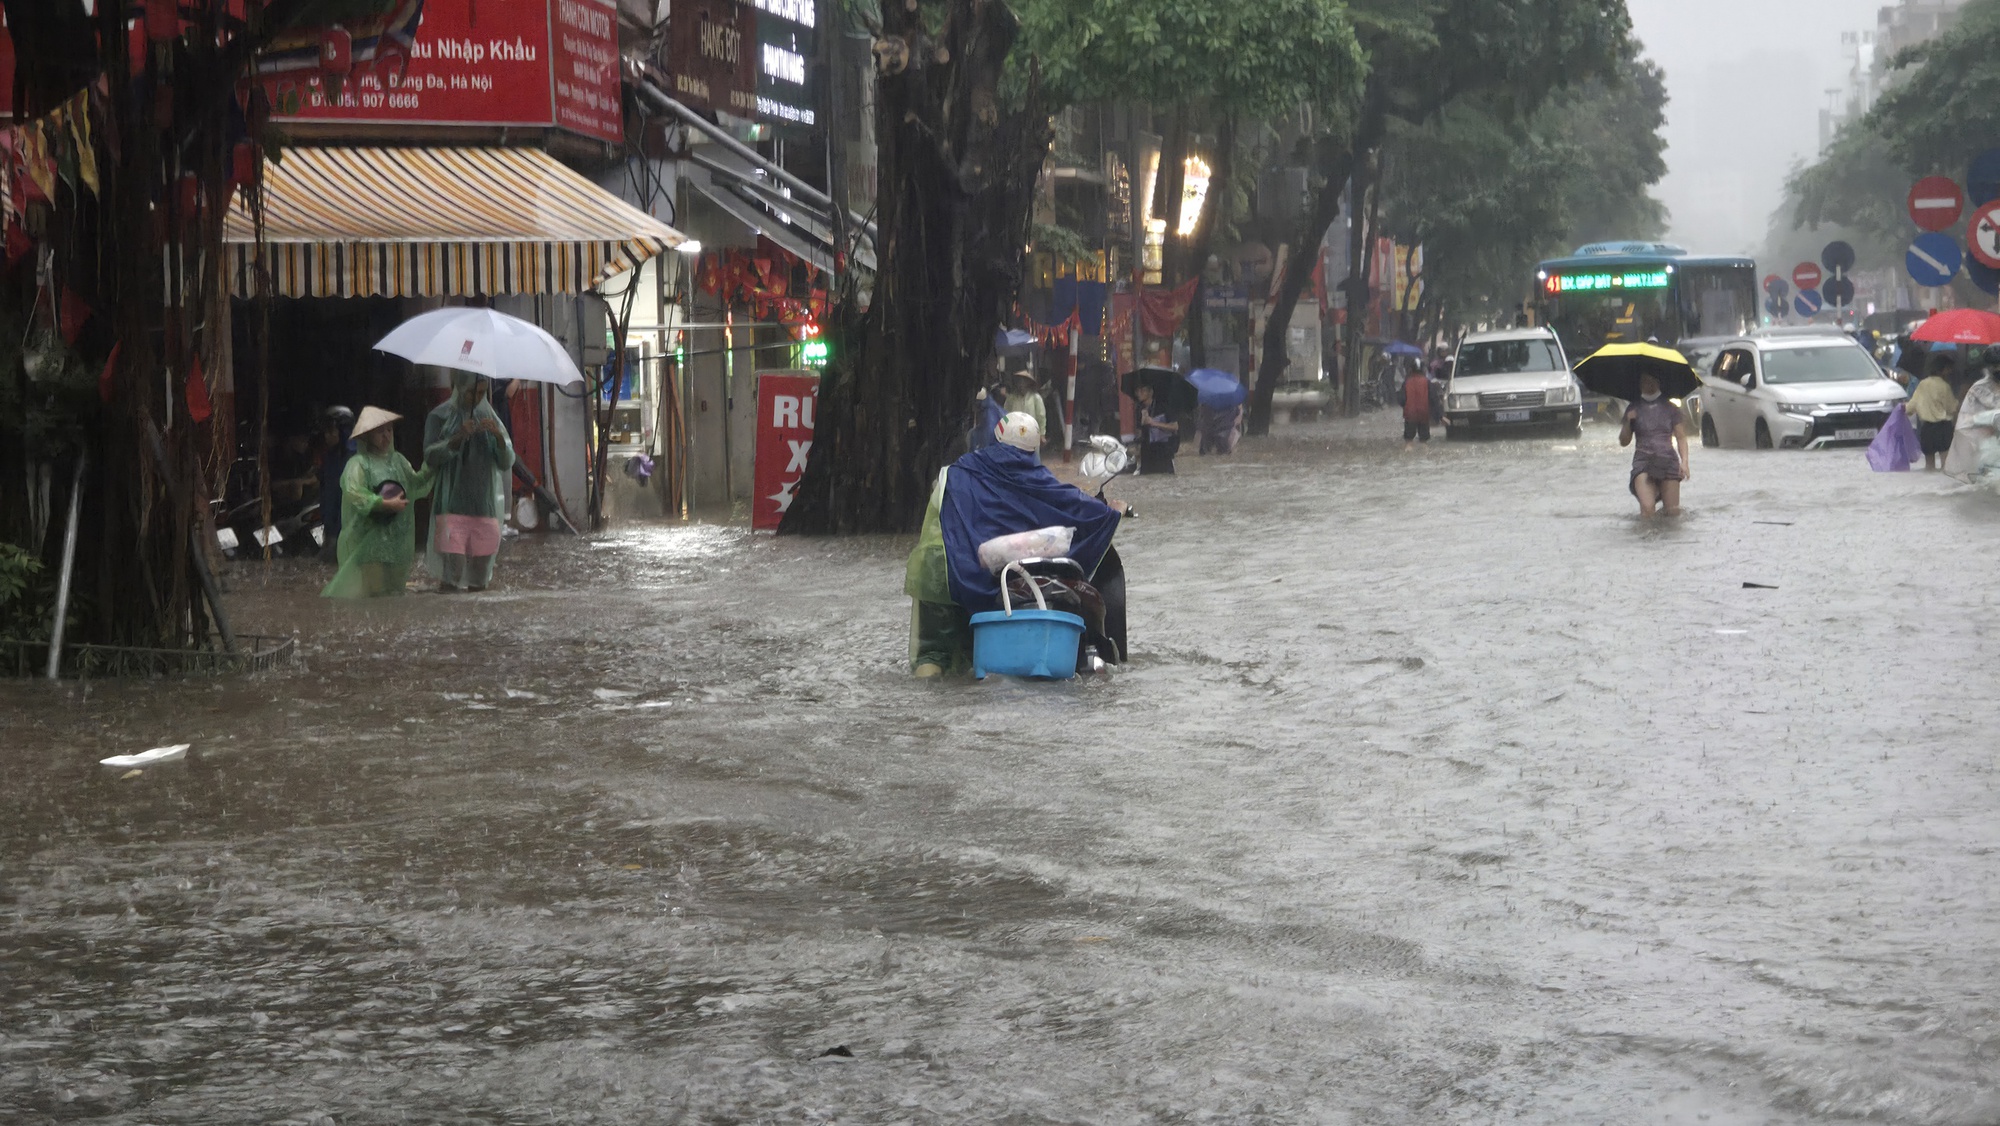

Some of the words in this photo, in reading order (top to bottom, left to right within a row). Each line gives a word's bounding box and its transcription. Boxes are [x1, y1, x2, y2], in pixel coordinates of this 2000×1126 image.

[590, 9, 611, 40] MOTOR
[437, 37, 484, 64] Nhập
[489, 35, 536, 60] Khẩu
[450, 73, 468, 89] Hà
[471, 74, 493, 93] Nội
[362, 92, 385, 108] 907
[389, 92, 419, 108] 6666
[1546, 275, 1561, 292] 41
